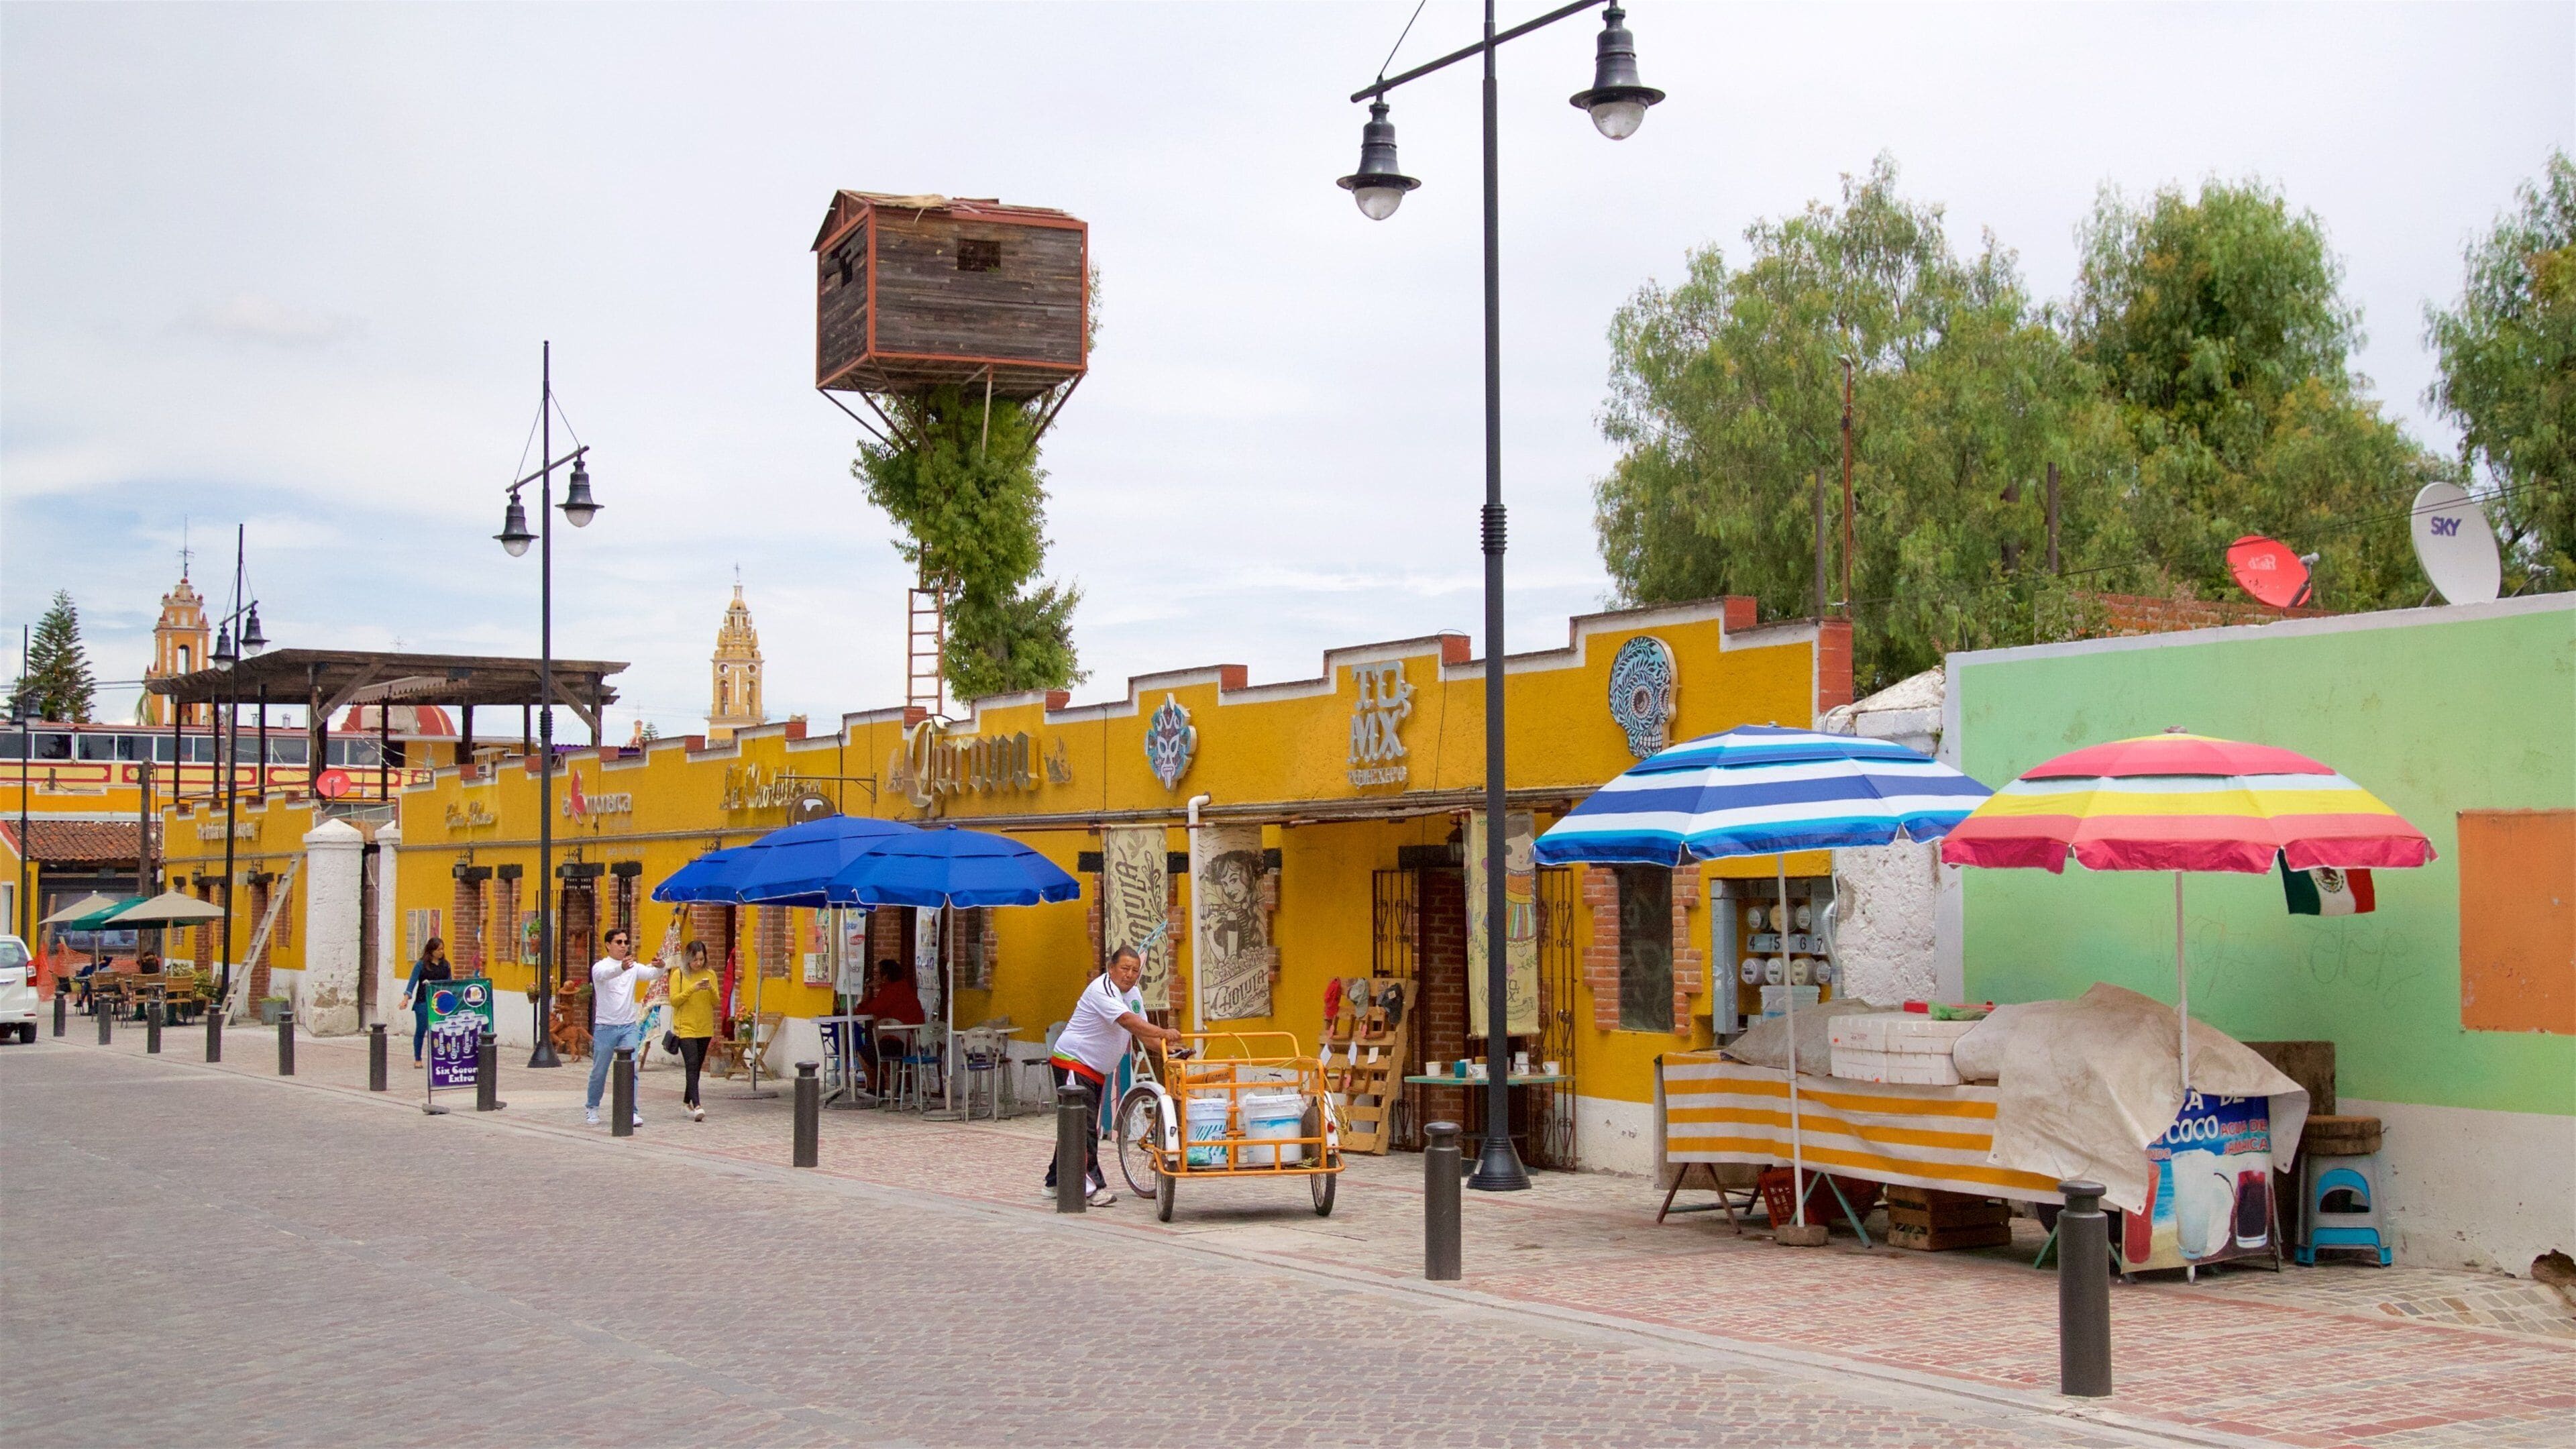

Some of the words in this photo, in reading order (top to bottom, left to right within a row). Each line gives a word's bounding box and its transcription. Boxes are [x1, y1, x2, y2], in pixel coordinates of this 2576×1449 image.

[2431, 517, 2462, 536] SKY
[1347, 709, 1407, 763] MX
[904, 716, 1040, 818] Corona
[1749, 936, 1756, 950] 4
[1774, 936, 1781, 950] 5
[1817, 938, 1823, 952] 7
[435, 1066, 450, 1075] Six
[451, 1065, 479, 1074] Coron
[449, 1074, 475, 1083] Extra
[2166, 1115, 2218, 1144] COCO
[2249, 1118, 2268, 1132] DE
[2224, 1138, 2269, 1155] JAMAICA
